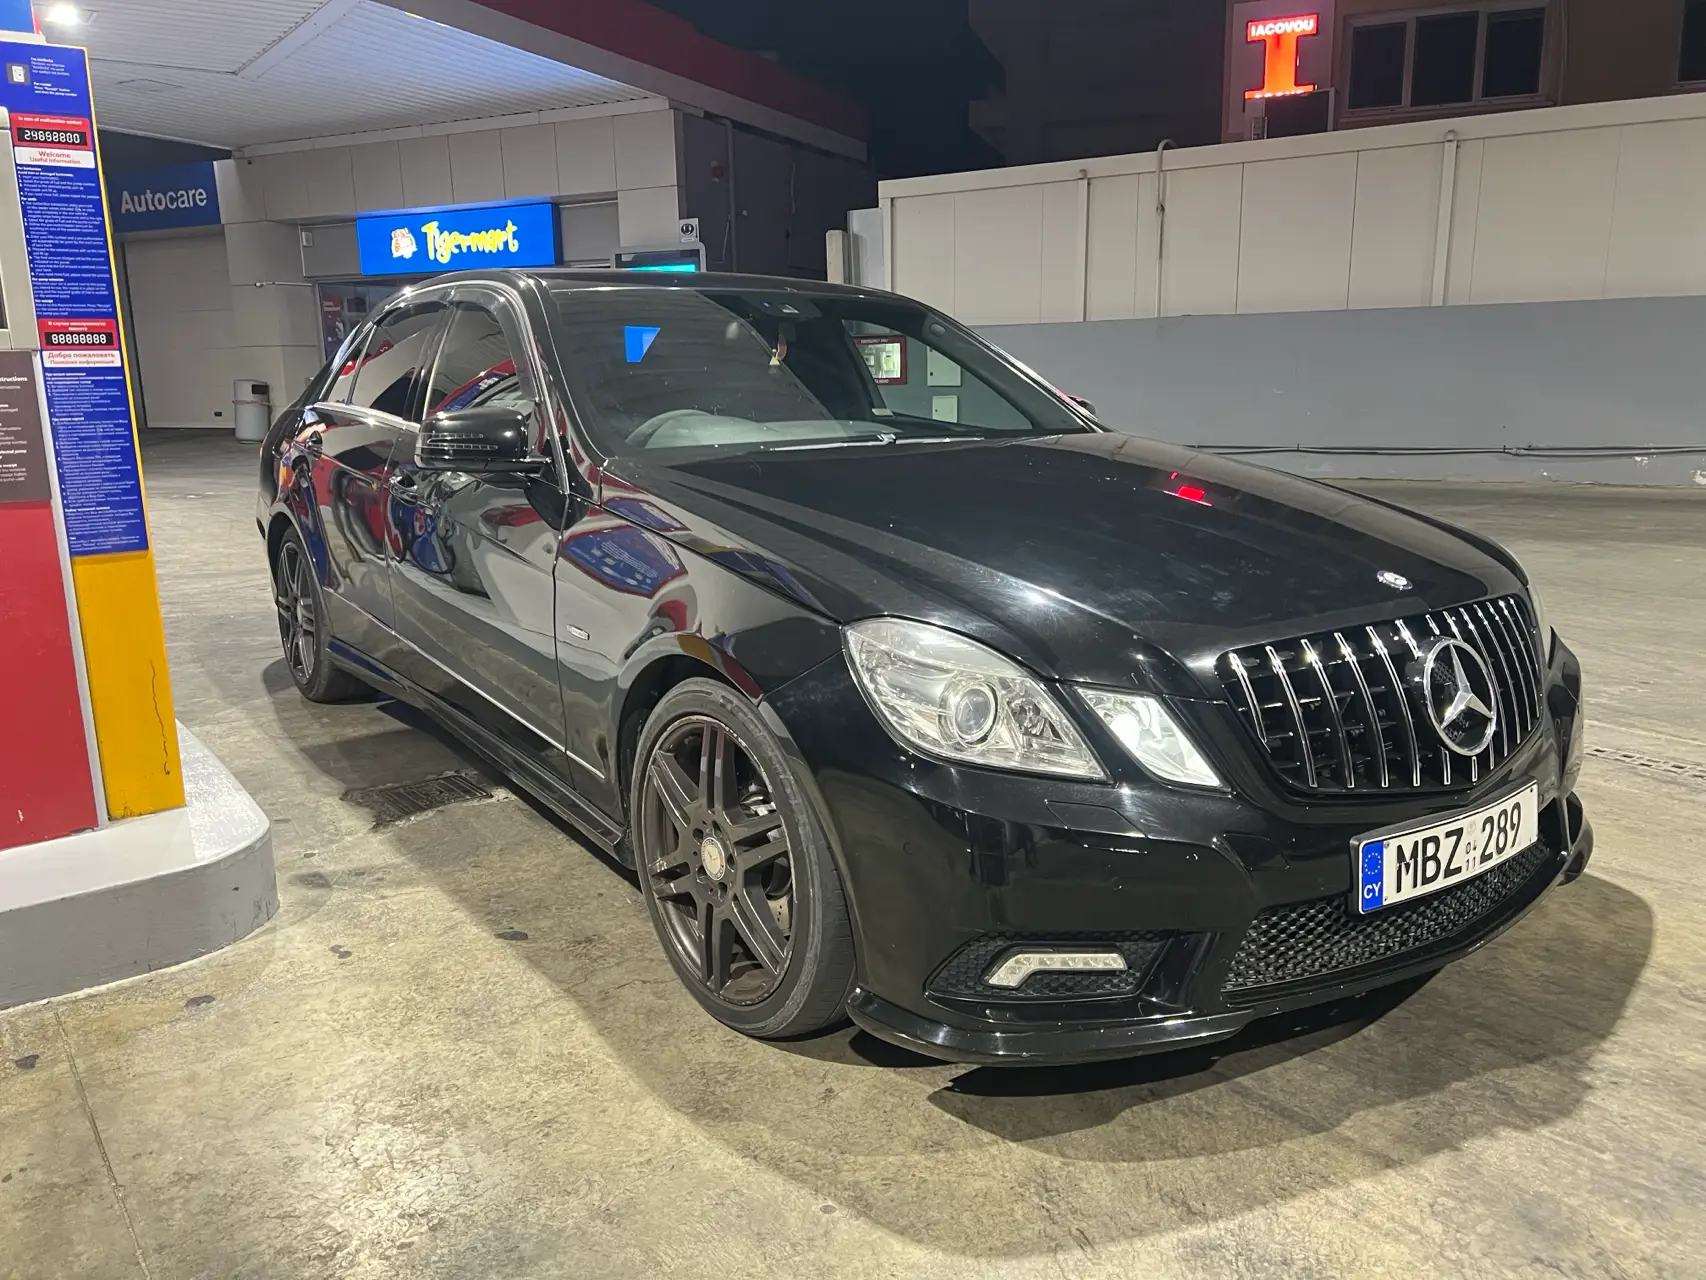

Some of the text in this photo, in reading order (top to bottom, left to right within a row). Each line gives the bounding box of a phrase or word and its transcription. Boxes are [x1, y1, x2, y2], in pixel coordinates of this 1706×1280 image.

[1251, 19, 1314, 36] IACOVOU
[38, 151, 70, 159] Welcome
[121, 188, 207, 214] Autocare
[421, 219, 519, 264] Tigermart
[1396, 801, 1522, 894] MBZ 289
[1364, 881, 1382, 900] CY
